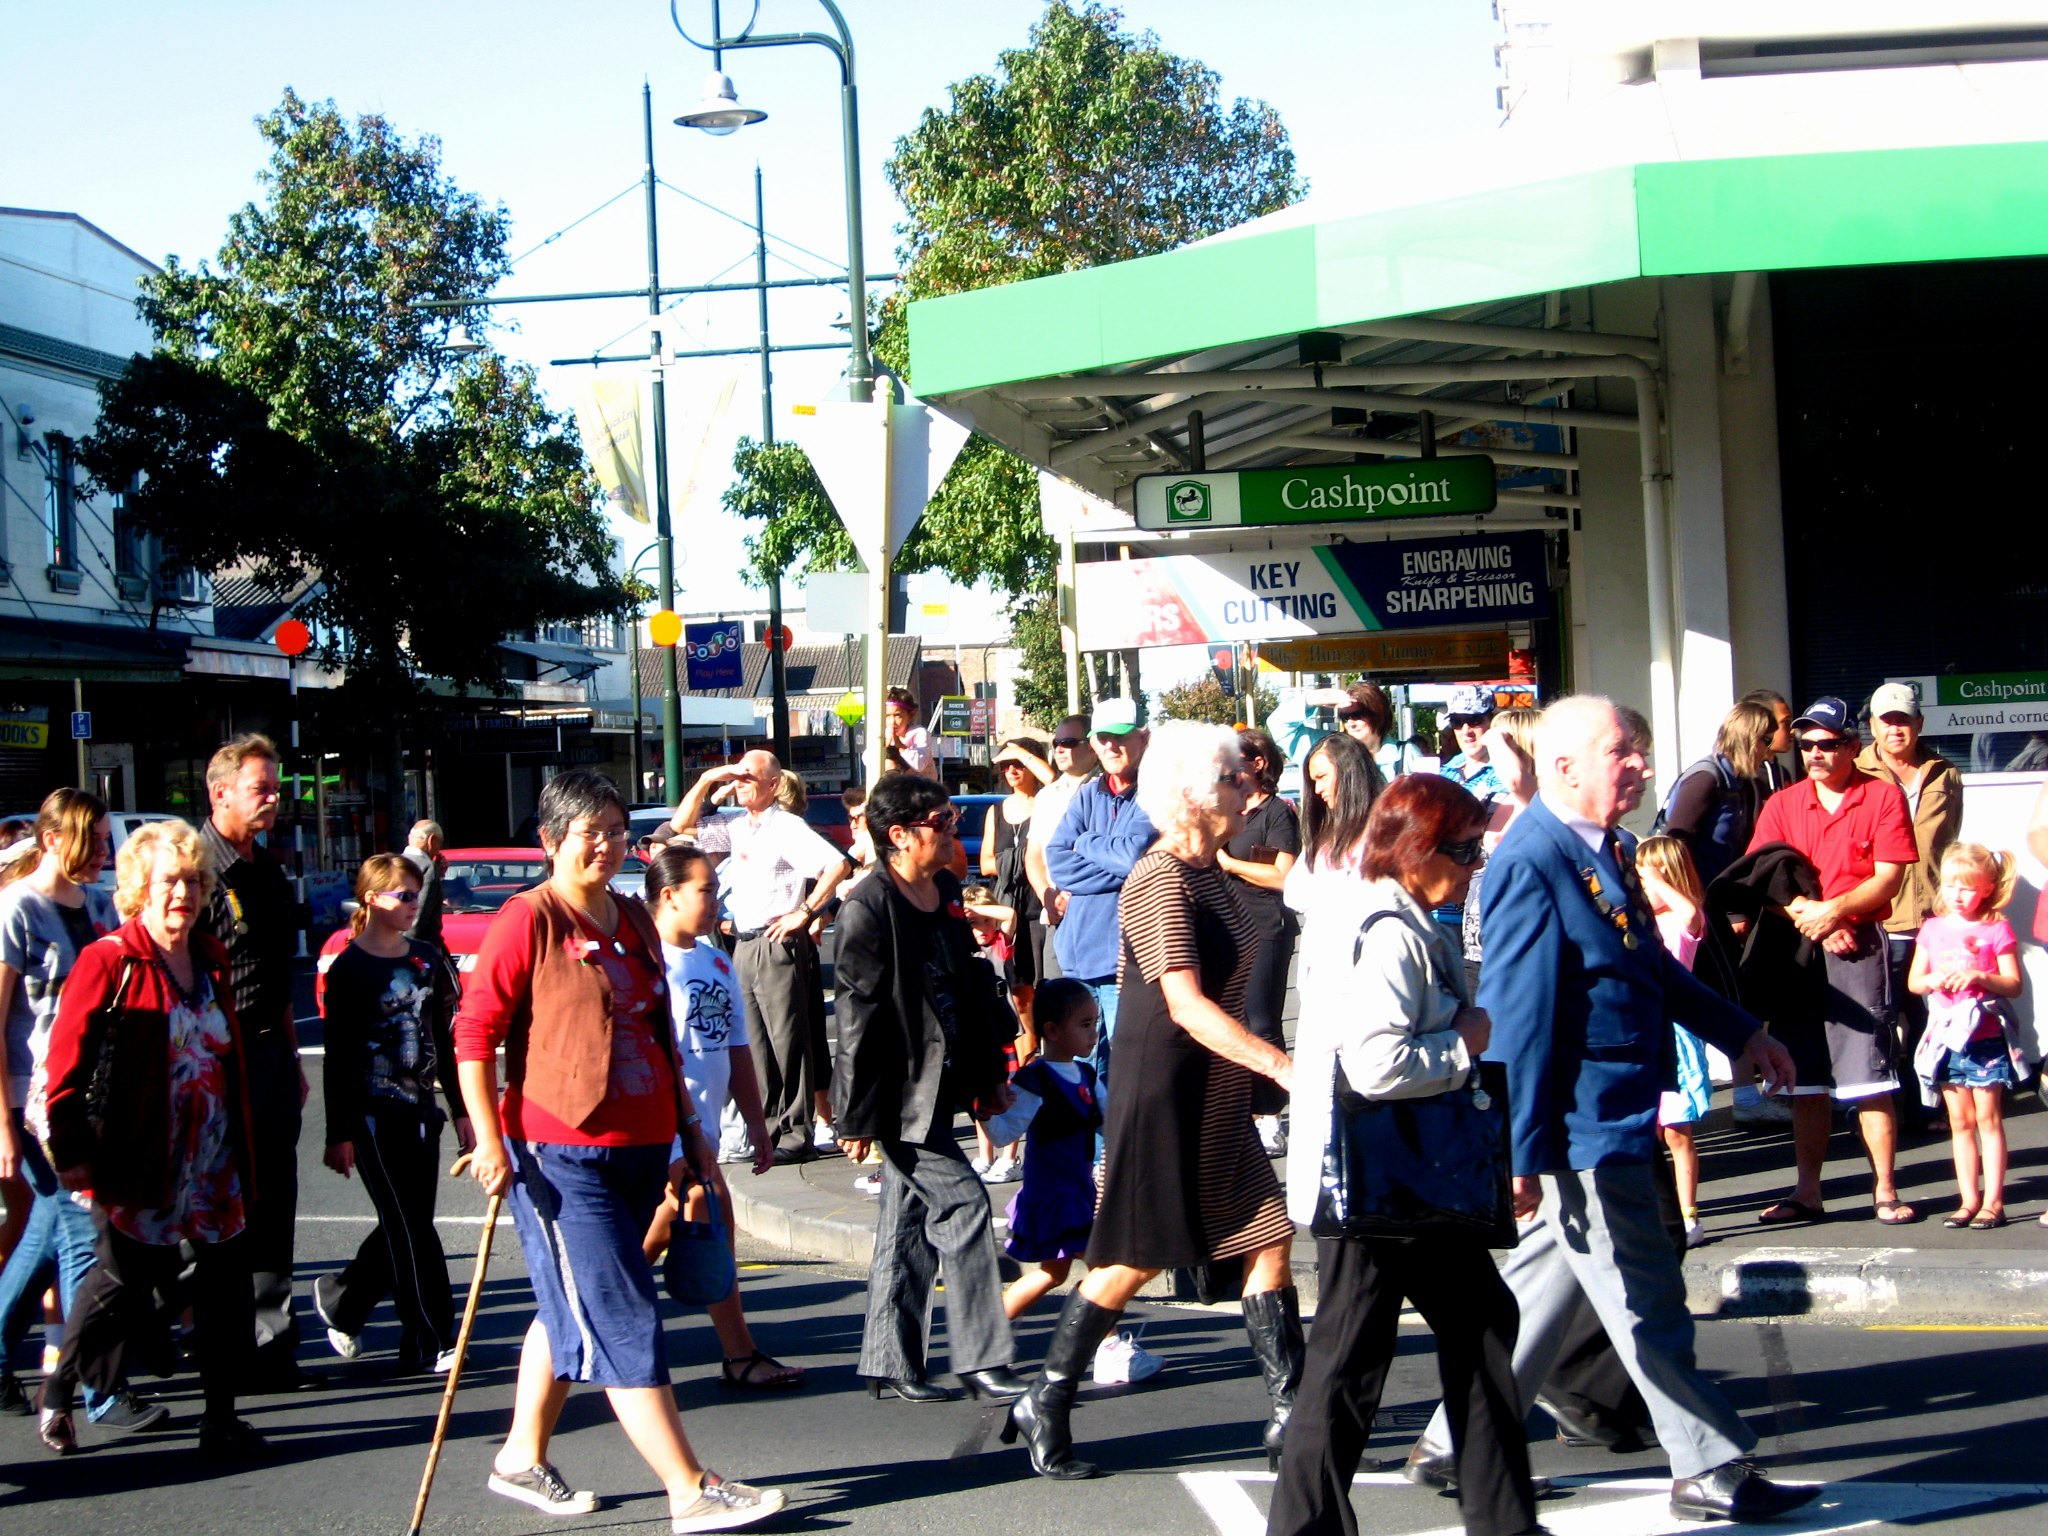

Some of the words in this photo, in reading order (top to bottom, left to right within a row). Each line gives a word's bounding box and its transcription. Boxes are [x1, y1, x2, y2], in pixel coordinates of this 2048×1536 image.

[1281, 472, 1452, 514] Cashpoint
[1402, 545, 1512, 575] ENGRAVING
[1249, 562, 1301, 590] KEY
[1400, 575, 1442, 588] Knife
[1446, 573, 1458, 583] &
[1463, 571, 1517, 583] Scissor
[1223, 592, 1337, 624] CUTTING
[1386, 581, 1534, 614] SHARPENING
[687, 632, 738, 660] LOTTO
[1266, 645, 1298, 664] The
[1960, 679, 2046, 699] Cashpoint
[78, 714, 84, 722] P
[556, 713, 589, 725] CENTRE
[1947, 710, 2005, 727] Around
